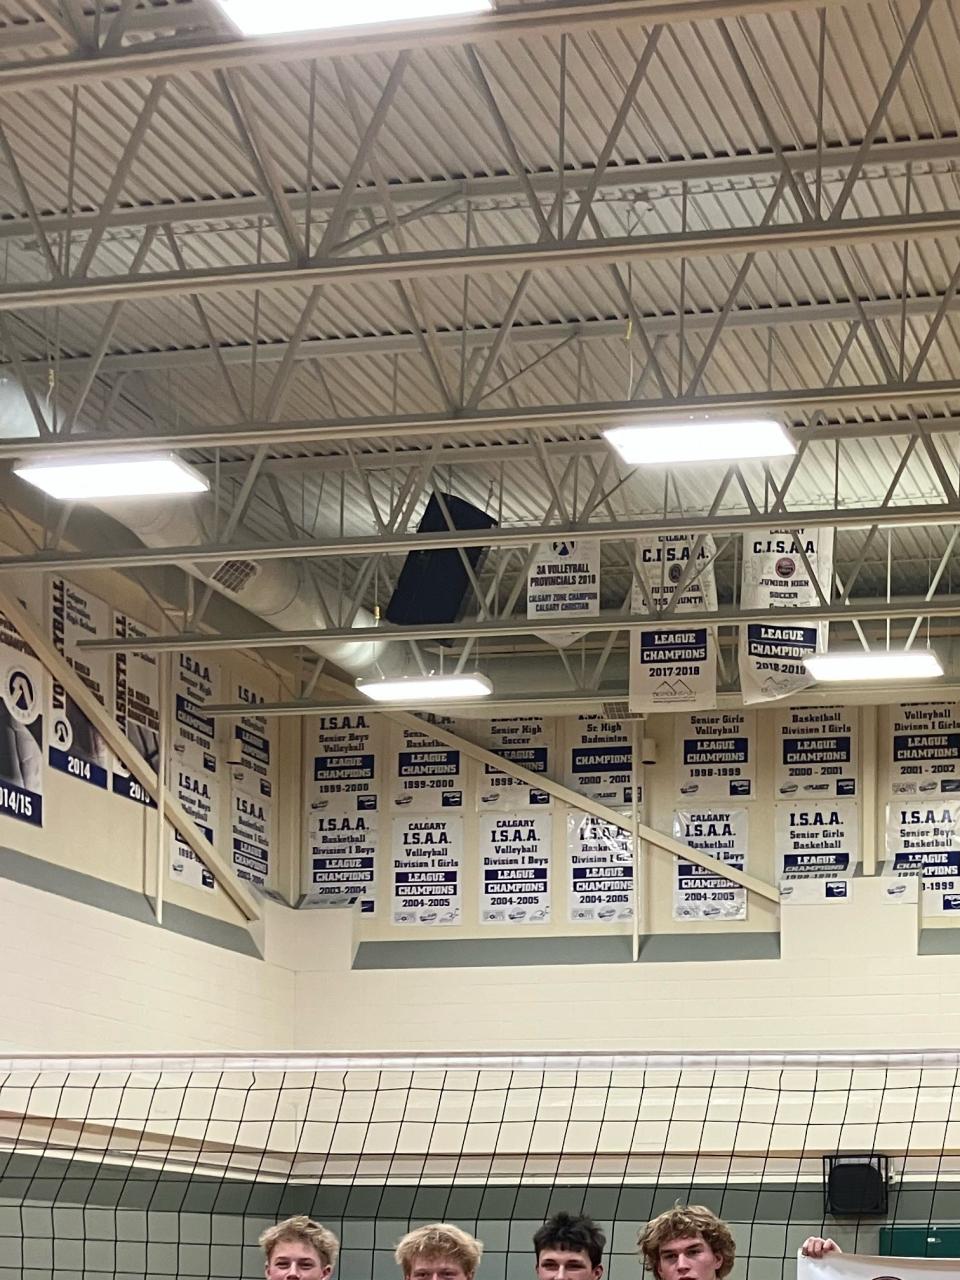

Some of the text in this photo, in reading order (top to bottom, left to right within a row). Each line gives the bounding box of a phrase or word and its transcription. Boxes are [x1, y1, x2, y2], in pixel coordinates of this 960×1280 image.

[530, 575, 577, 587] PROVINCIALS
[654, 633, 696, 645] LEAGUE
[760, 628, 804, 641] LEAGUE
[643, 648, 705, 661] CHAMPIONS
[791, 712, 841, 723] Basketball
[904, 709, 951, 720] Volleyball
[320, 716, 370, 731] I.S.A.A.
[937, 720, 960, 730] Girls
[907, 736, 948, 747] LEAGUE
[687, 752, 745, 762] CHAMPIONS
[896, 748, 958, 759] CHAMPIONS
[67, 756, 91, 780] 2014
[789, 811, 844, 826] I.S.A.A.
[901, 809, 956, 824] I.S.A.A.
[318, 817, 370, 832] I.S.A.A.
[408, 822, 447, 831] CALGARY
[496, 820, 535, 828] CALGARY
[403, 832, 452, 845] I.S.A.A.
[490, 829, 541, 843] I.S.A.A.
[789, 829, 845, 840] Senior Girls
[793, 840, 842, 850] Basketball
[903, 838, 953, 849] Basketball
[405, 847, 448, 859] Volleyball
[494, 844, 538, 855] Volleyball
[394, 859, 459, 869] Division Girls
[484, 857, 519, 866] Division
[408, 872, 445, 882] LEAGUE
[497, 869, 535, 879] LEAGUE
[585, 867, 624, 878] LEAGUE
[398, 884, 455, 896] CHAMPIONS
[487, 882, 545, 892] CHAMPIONS
